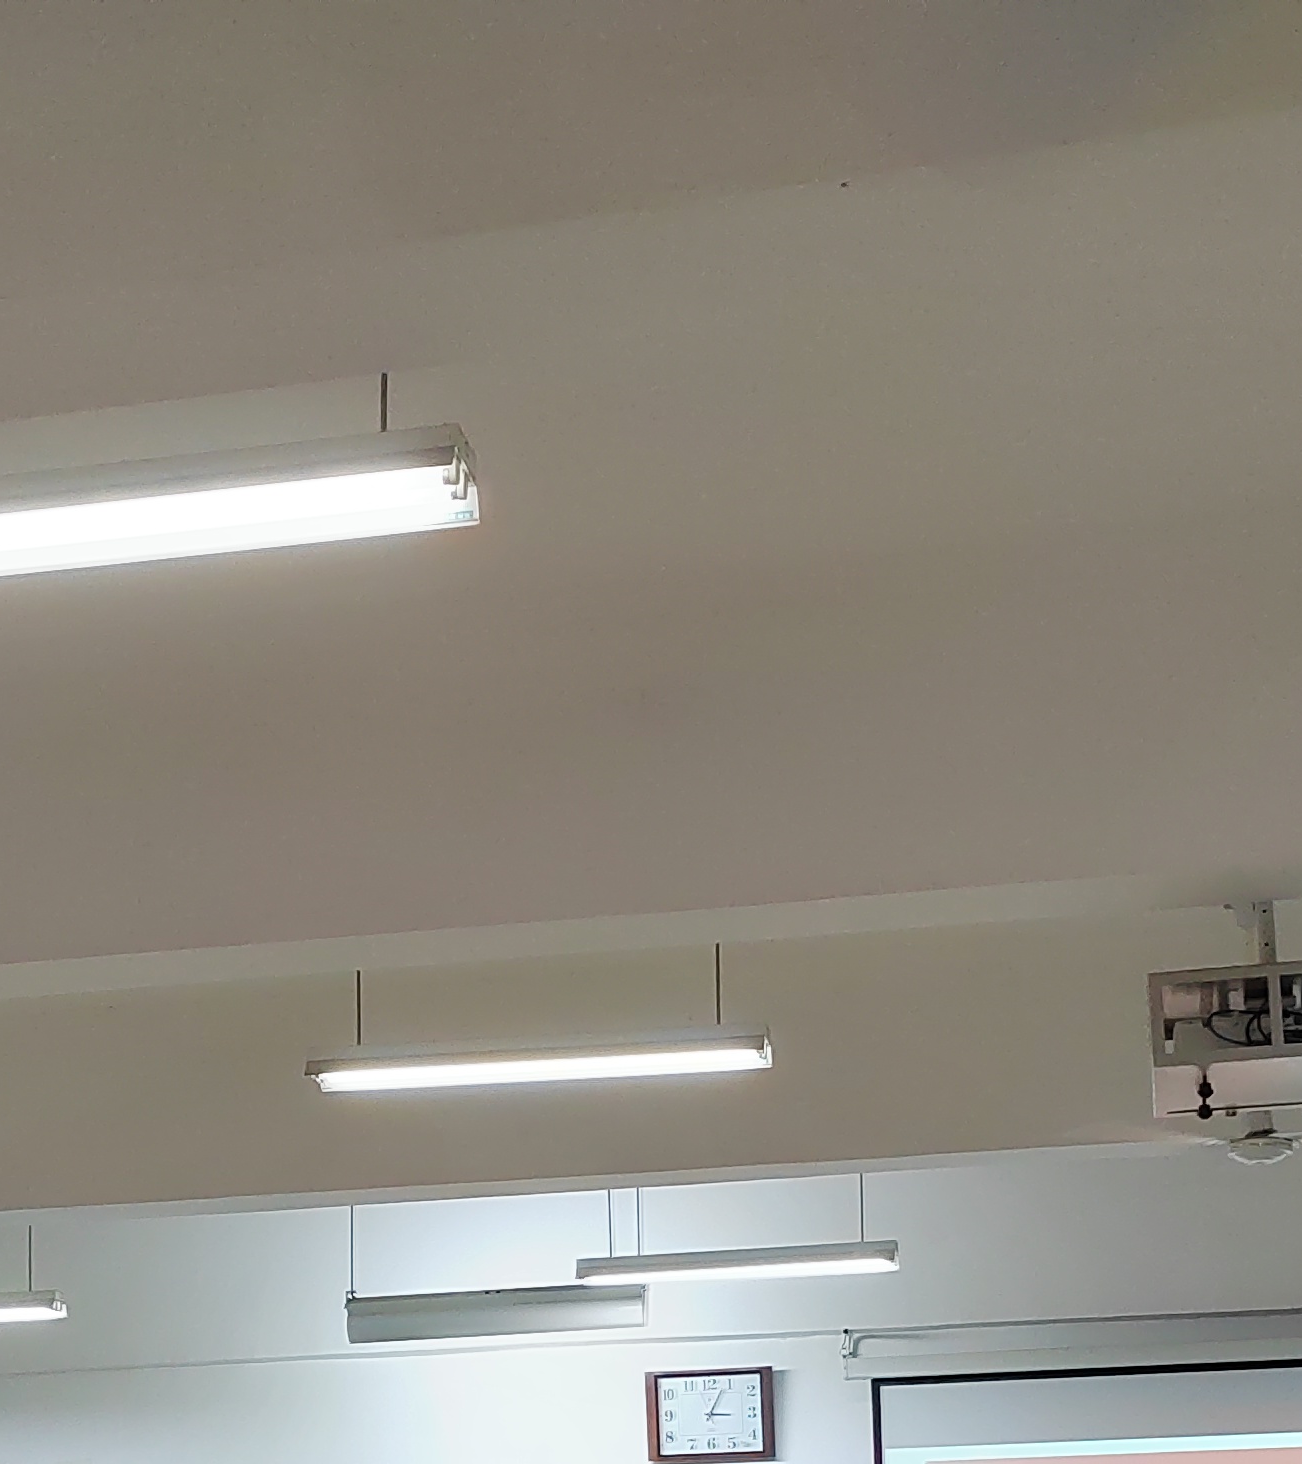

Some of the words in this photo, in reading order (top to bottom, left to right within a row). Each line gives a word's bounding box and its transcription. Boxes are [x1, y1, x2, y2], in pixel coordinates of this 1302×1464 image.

[683, 1380, 694, 1392] 11
[702, 1378, 717, 1391] 12
[727, 1378, 733, 1390] 1
[746, 1384, 757, 1397] 2
[663, 1389, 674, 1401] 10
[664, 1409, 674, 1422] 9
[747, 1406, 757, 1419] 3
[665, 1431, 675, 1443] 8
[748, 1428, 757, 1441] 4
[687, 1438, 698, 1450] 7
[707, 1437, 717, 1450] 6
[727, 1436, 737, 1449] 5
